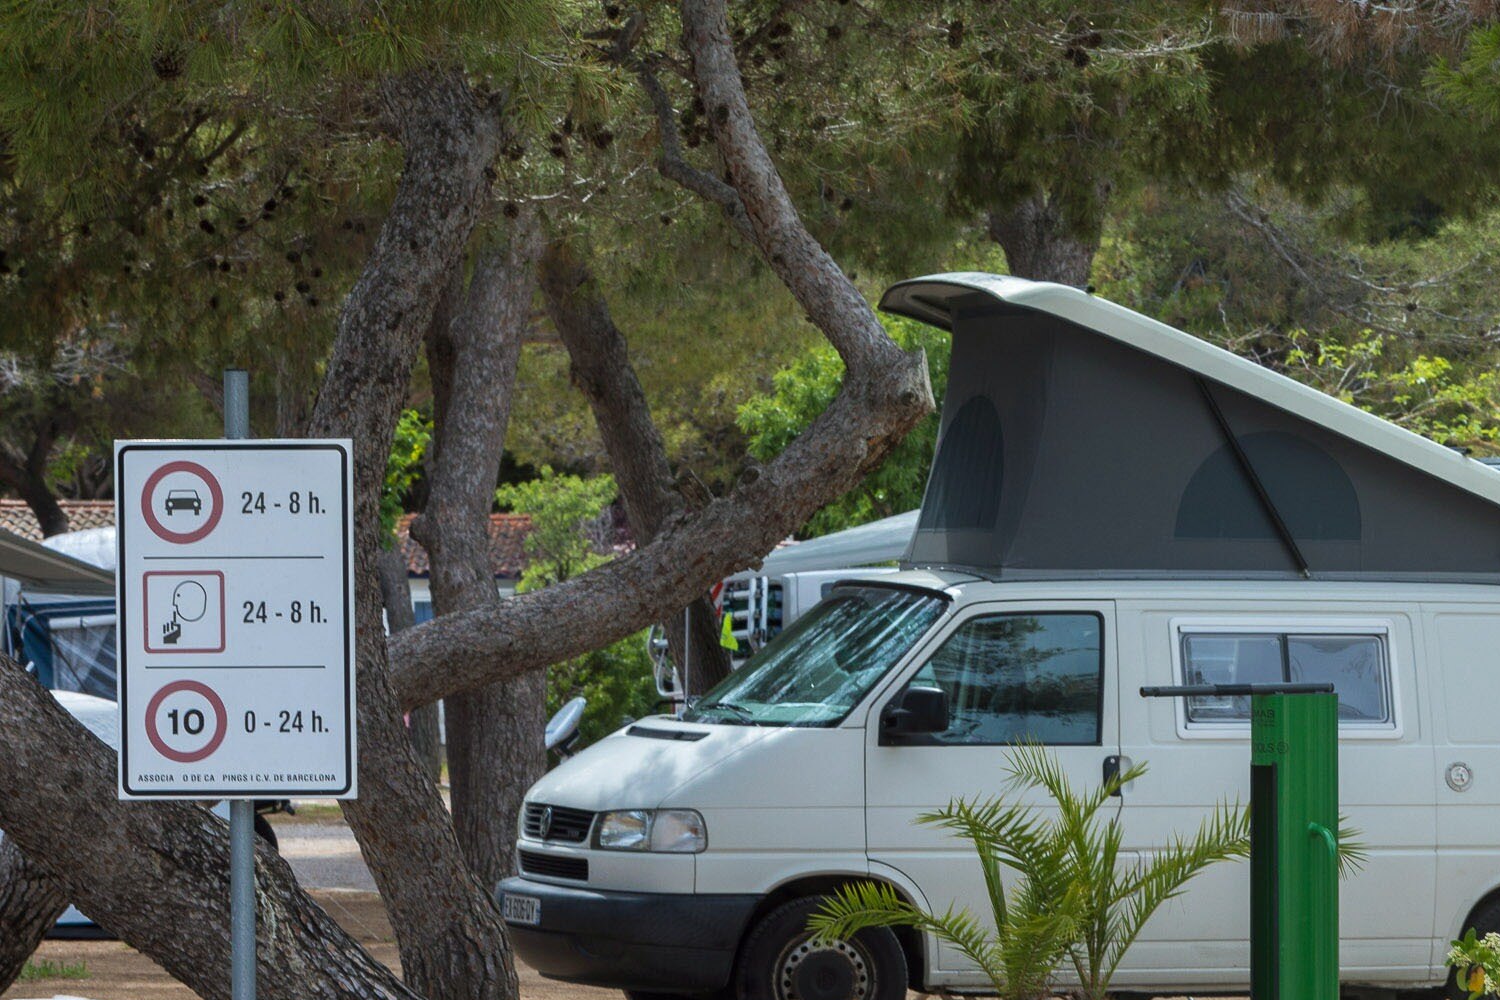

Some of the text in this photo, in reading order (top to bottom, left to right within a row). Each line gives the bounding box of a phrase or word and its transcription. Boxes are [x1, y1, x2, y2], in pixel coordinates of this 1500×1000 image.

[241, 491, 266, 514] 24
[289, 491, 301, 514] 8
[308, 491, 326, 514] h.
[242, 601, 267, 624] 24
[290, 601, 302, 624] 8
[310, 600, 328, 624] h.
[167, 708, 205, 735] 10
[244, 711, 256, 733] 0
[279, 711, 303, 733] 24
[312, 710, 329, 733] h.
[191, 774, 201, 782] DE
[274, 774, 284, 782] DE
[287, 774, 336, 782] BARCELONA
